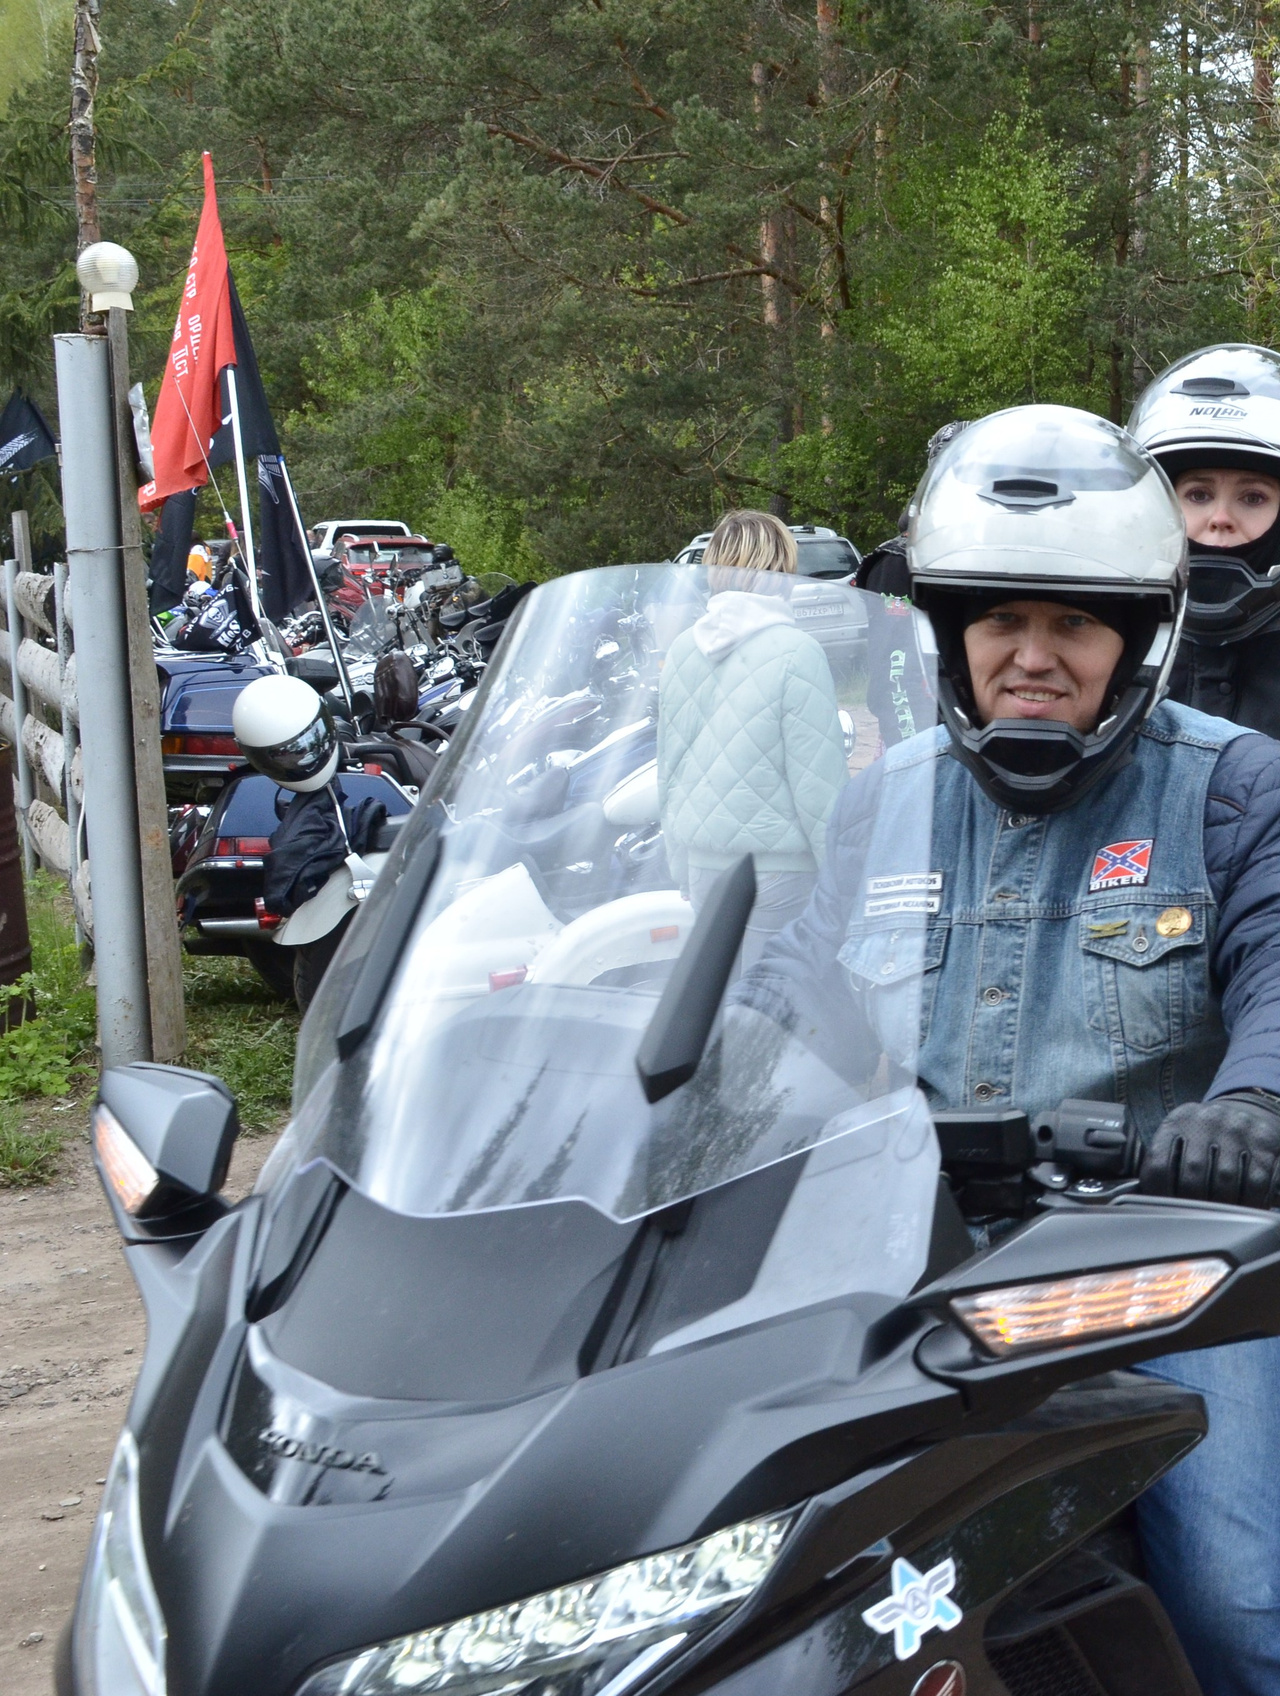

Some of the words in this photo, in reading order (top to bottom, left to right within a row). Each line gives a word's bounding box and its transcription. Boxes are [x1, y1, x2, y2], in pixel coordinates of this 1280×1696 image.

[1189, 406, 1248, 419] NOLAN
[1090, 875, 1146, 891] BIKER
[259, 1428, 388, 1476] HONDA
